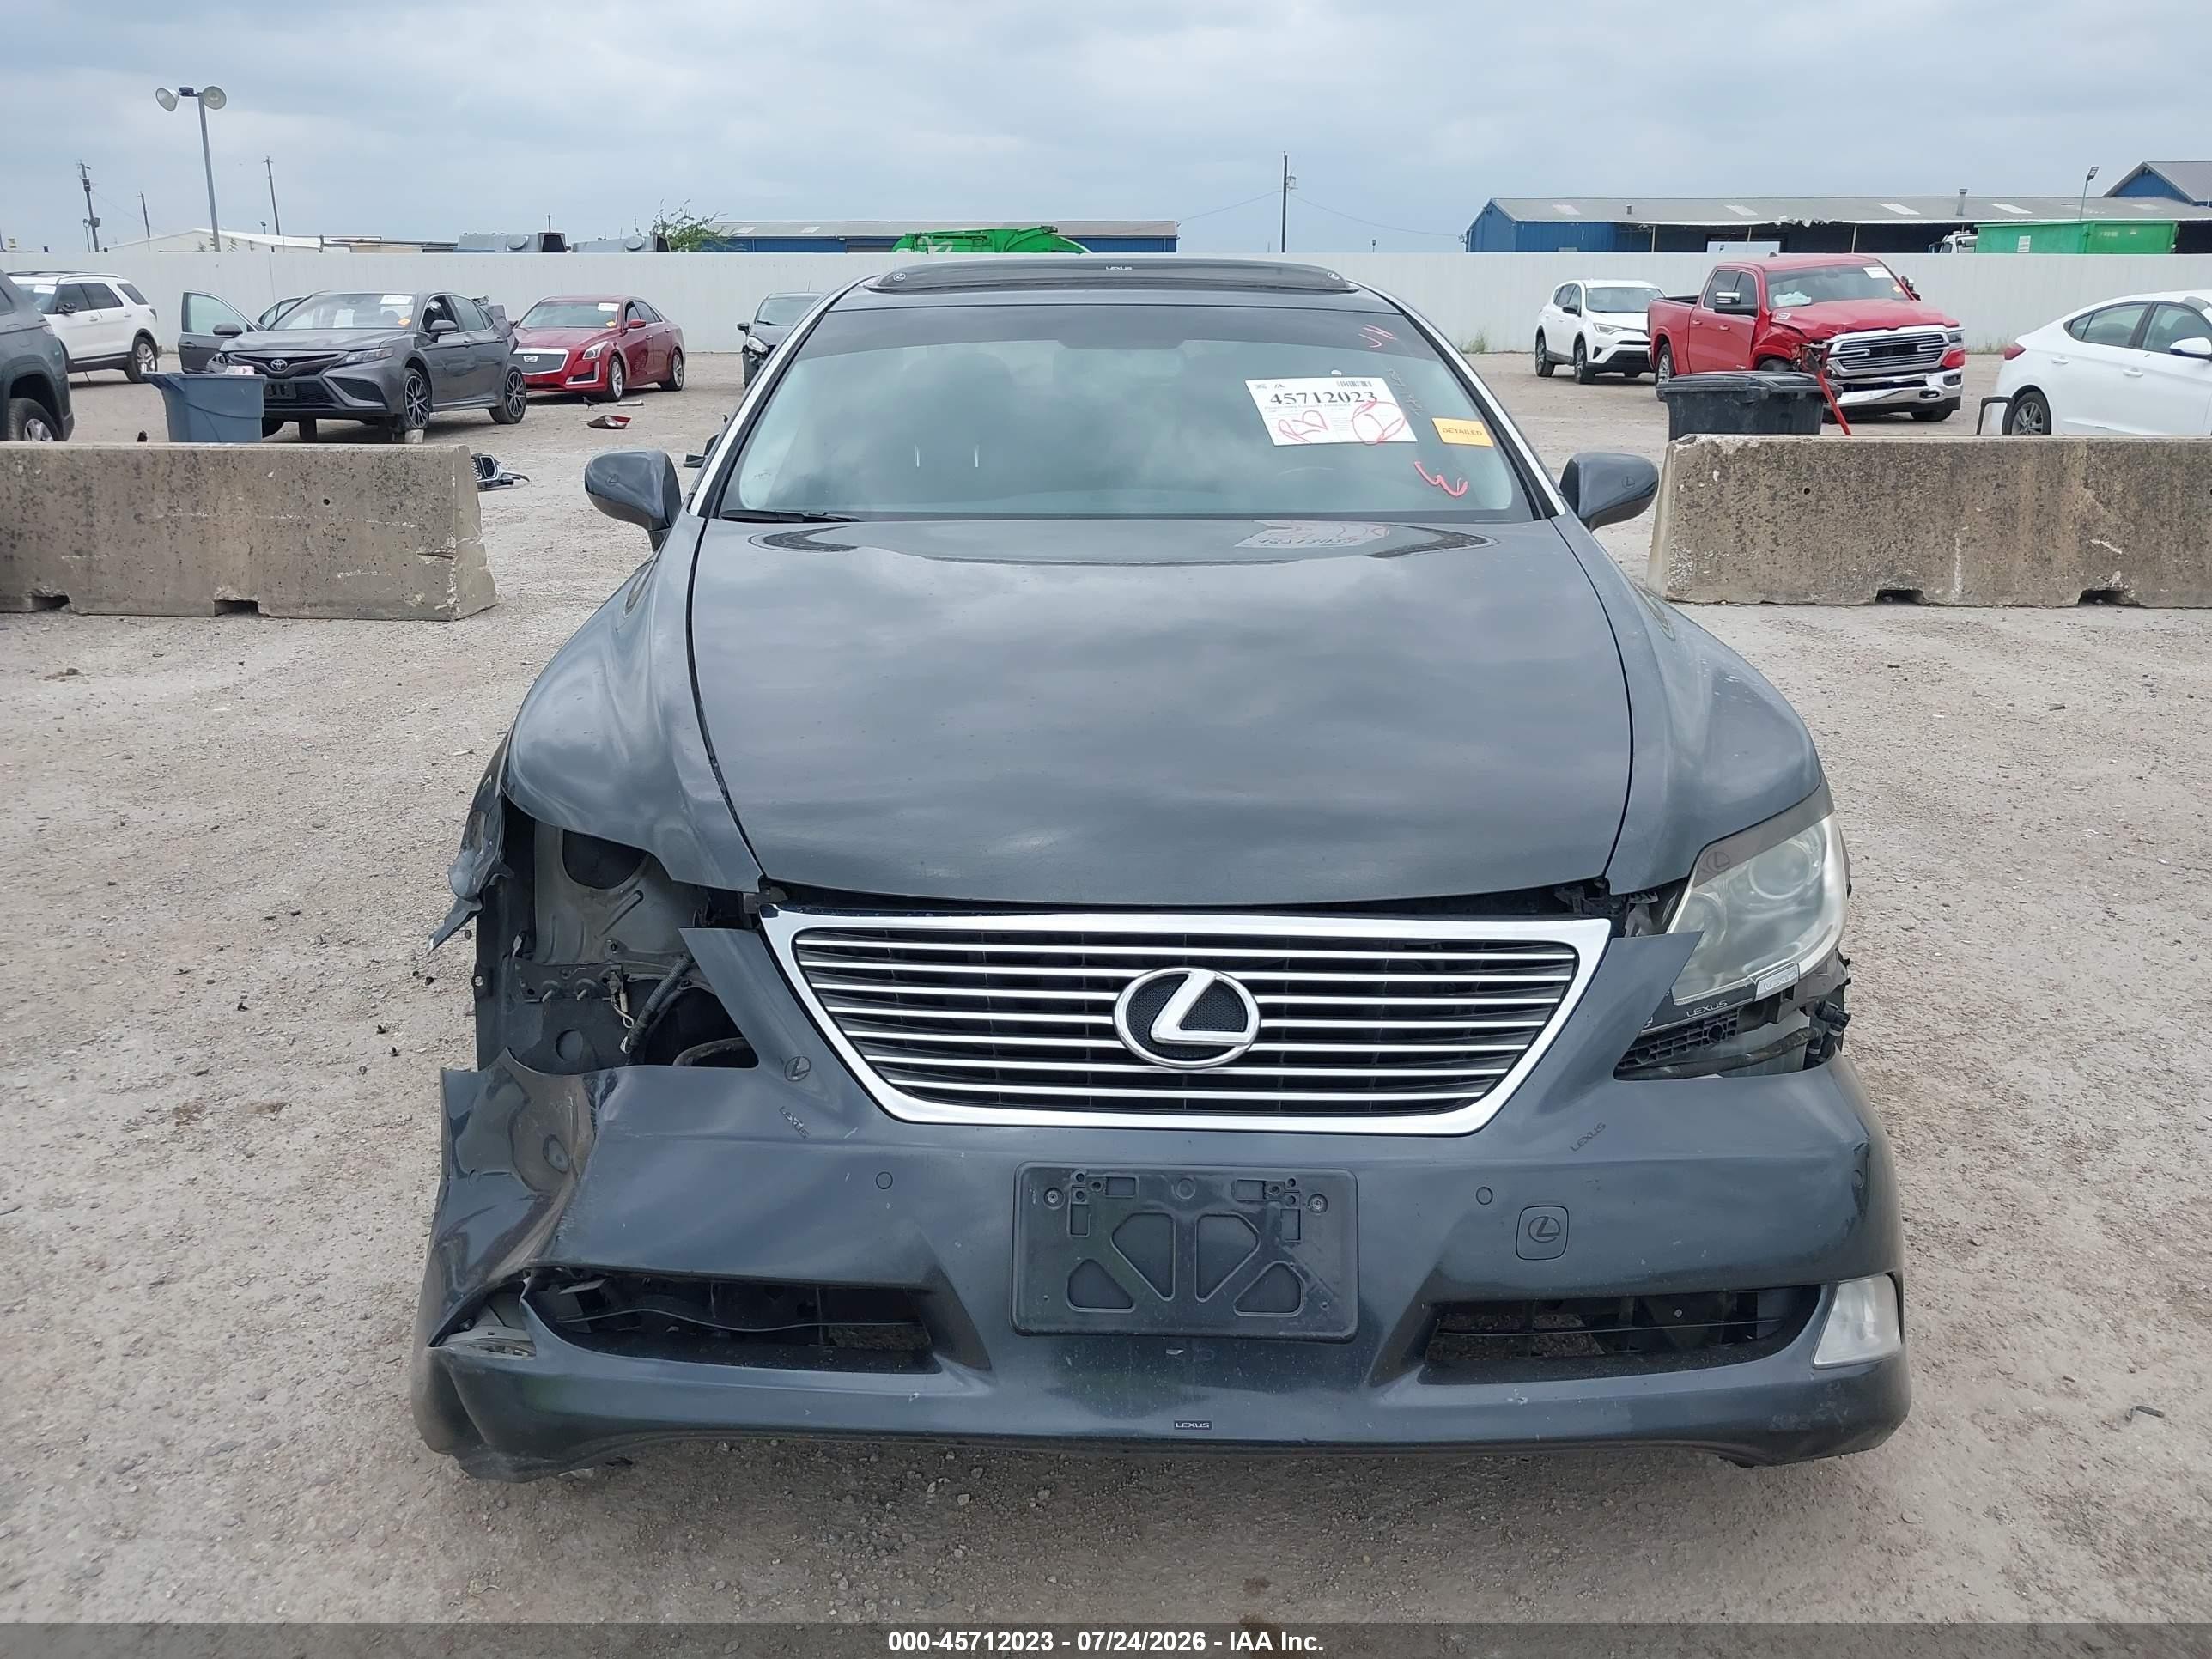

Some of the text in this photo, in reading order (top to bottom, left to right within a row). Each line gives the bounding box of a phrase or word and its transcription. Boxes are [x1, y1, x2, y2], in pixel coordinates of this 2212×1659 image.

[1270, 391, 1378, 405] 45712023
[1686, 1000, 1728, 1018] LEXUS
[1569, 1121, 1606, 1152] LEXUS
